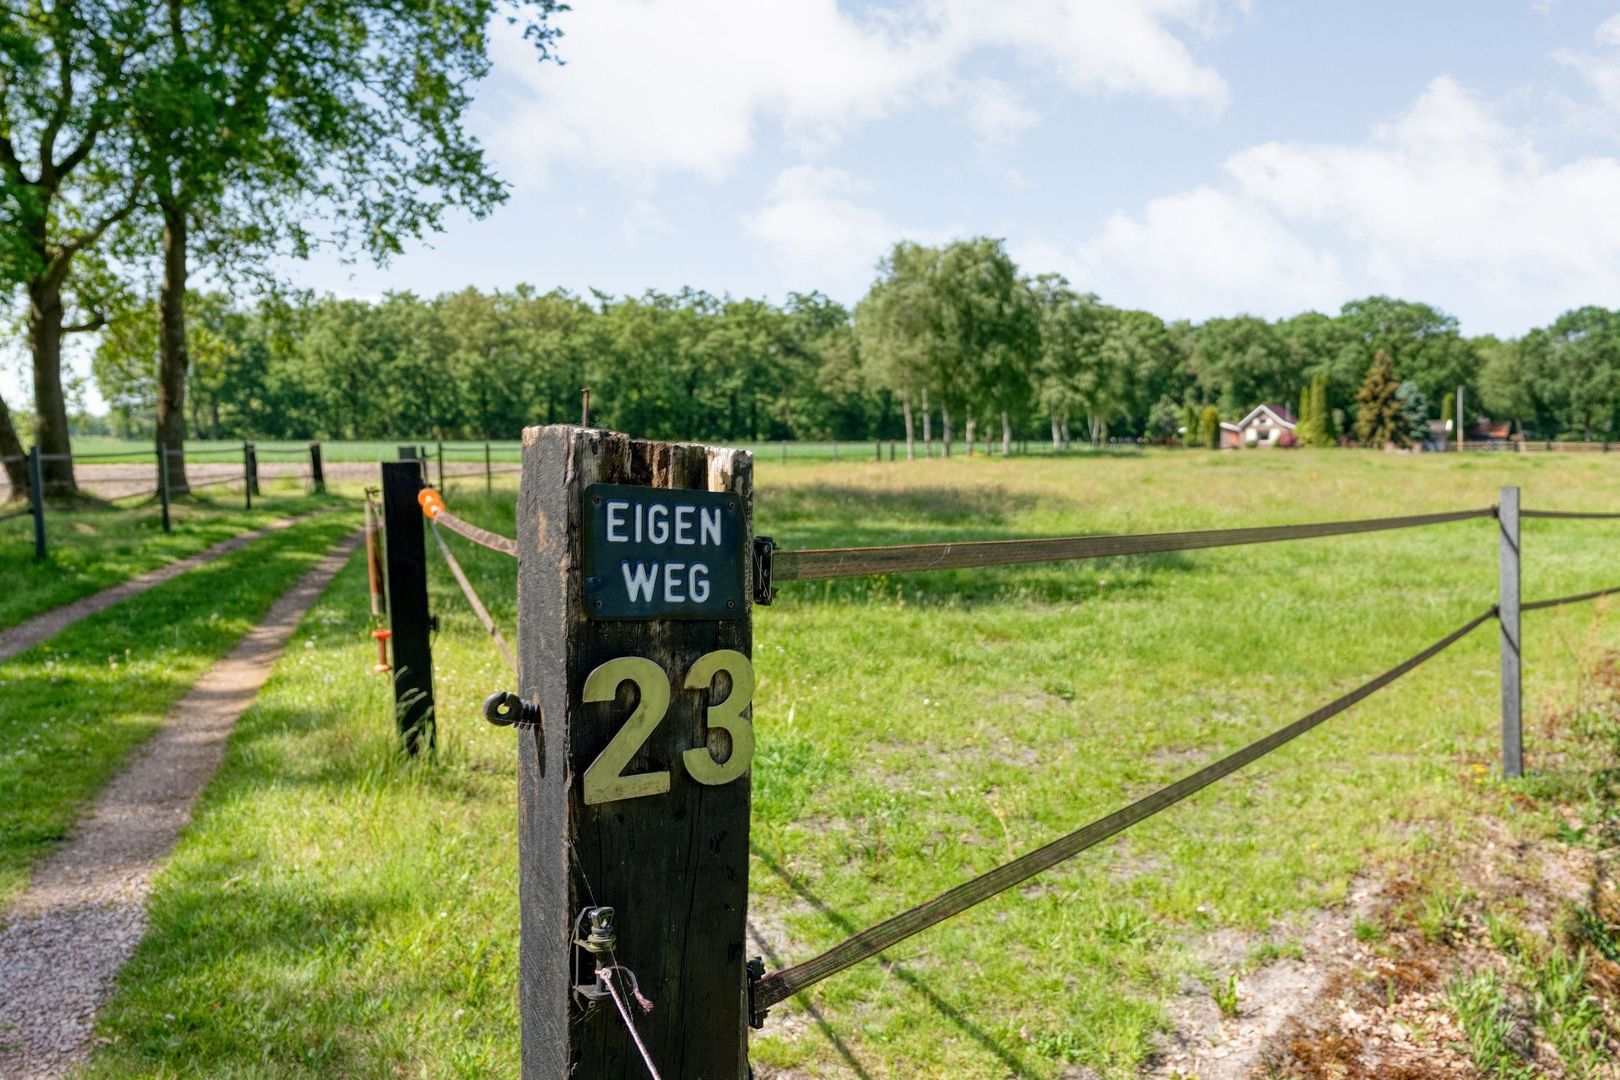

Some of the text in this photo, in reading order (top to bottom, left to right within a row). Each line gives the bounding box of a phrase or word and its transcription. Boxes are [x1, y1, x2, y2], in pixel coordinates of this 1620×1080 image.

[606, 501, 722, 547] EIGEN
[621, 562, 710, 603] WEG
[583, 649, 755, 805] 23
